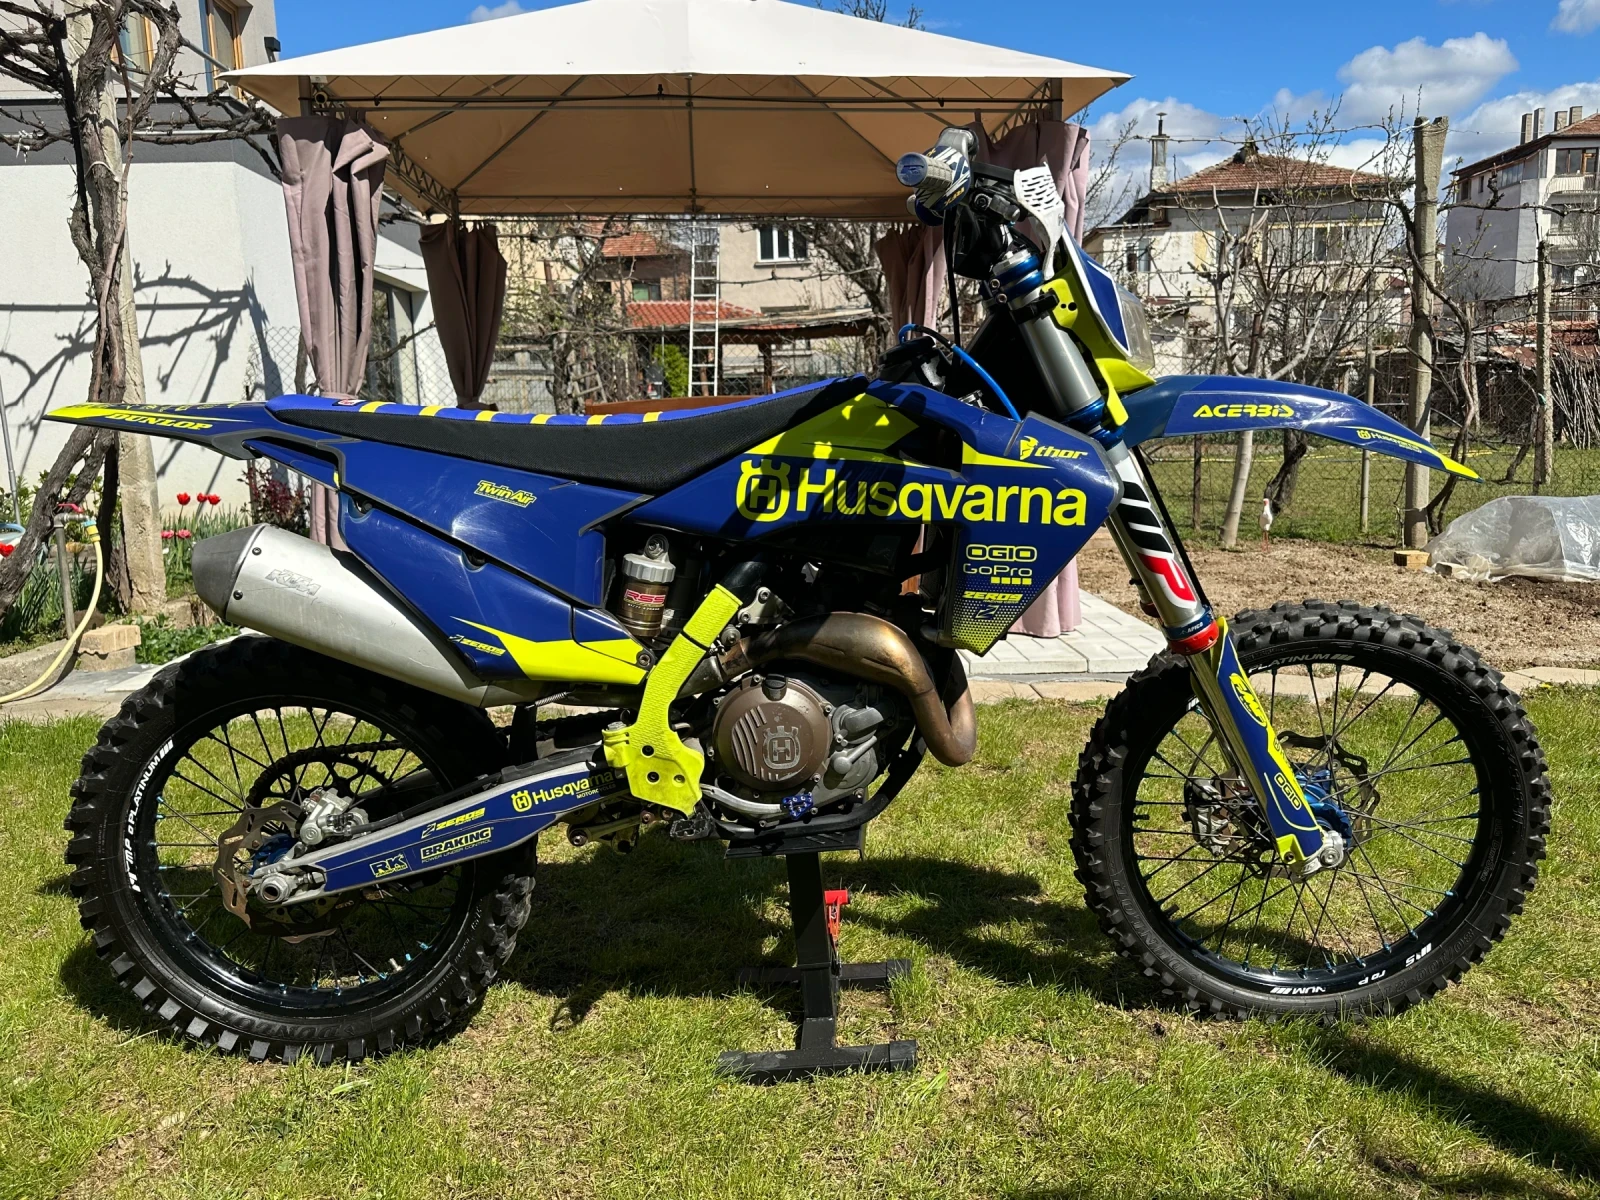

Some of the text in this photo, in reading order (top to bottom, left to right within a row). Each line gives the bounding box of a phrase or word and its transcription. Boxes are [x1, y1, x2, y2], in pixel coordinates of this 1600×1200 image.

[105, 413, 214, 431] DUNLOP
[1192, 404, 1295, 418] ACERBIS
[1034, 445, 1089, 459] thor
[479, 482, 512, 499] Twin
[510, 491, 534, 504] Air
[796, 467, 1087, 527] Husqvarna
[965, 543, 1038, 563] OGIO
[963, 563, 1033, 577] GoPro
[623, 588, 667, 605] RSS
[127, 756, 162, 826] PLATINUM
[531, 771, 614, 805] Husqvarna
[1273, 772, 1303, 811] OGIO
[421, 828, 491, 858] BRAKING
[421, 838, 493, 864] POWER UNDER CONTROL
[370, 854, 408, 876] RK
